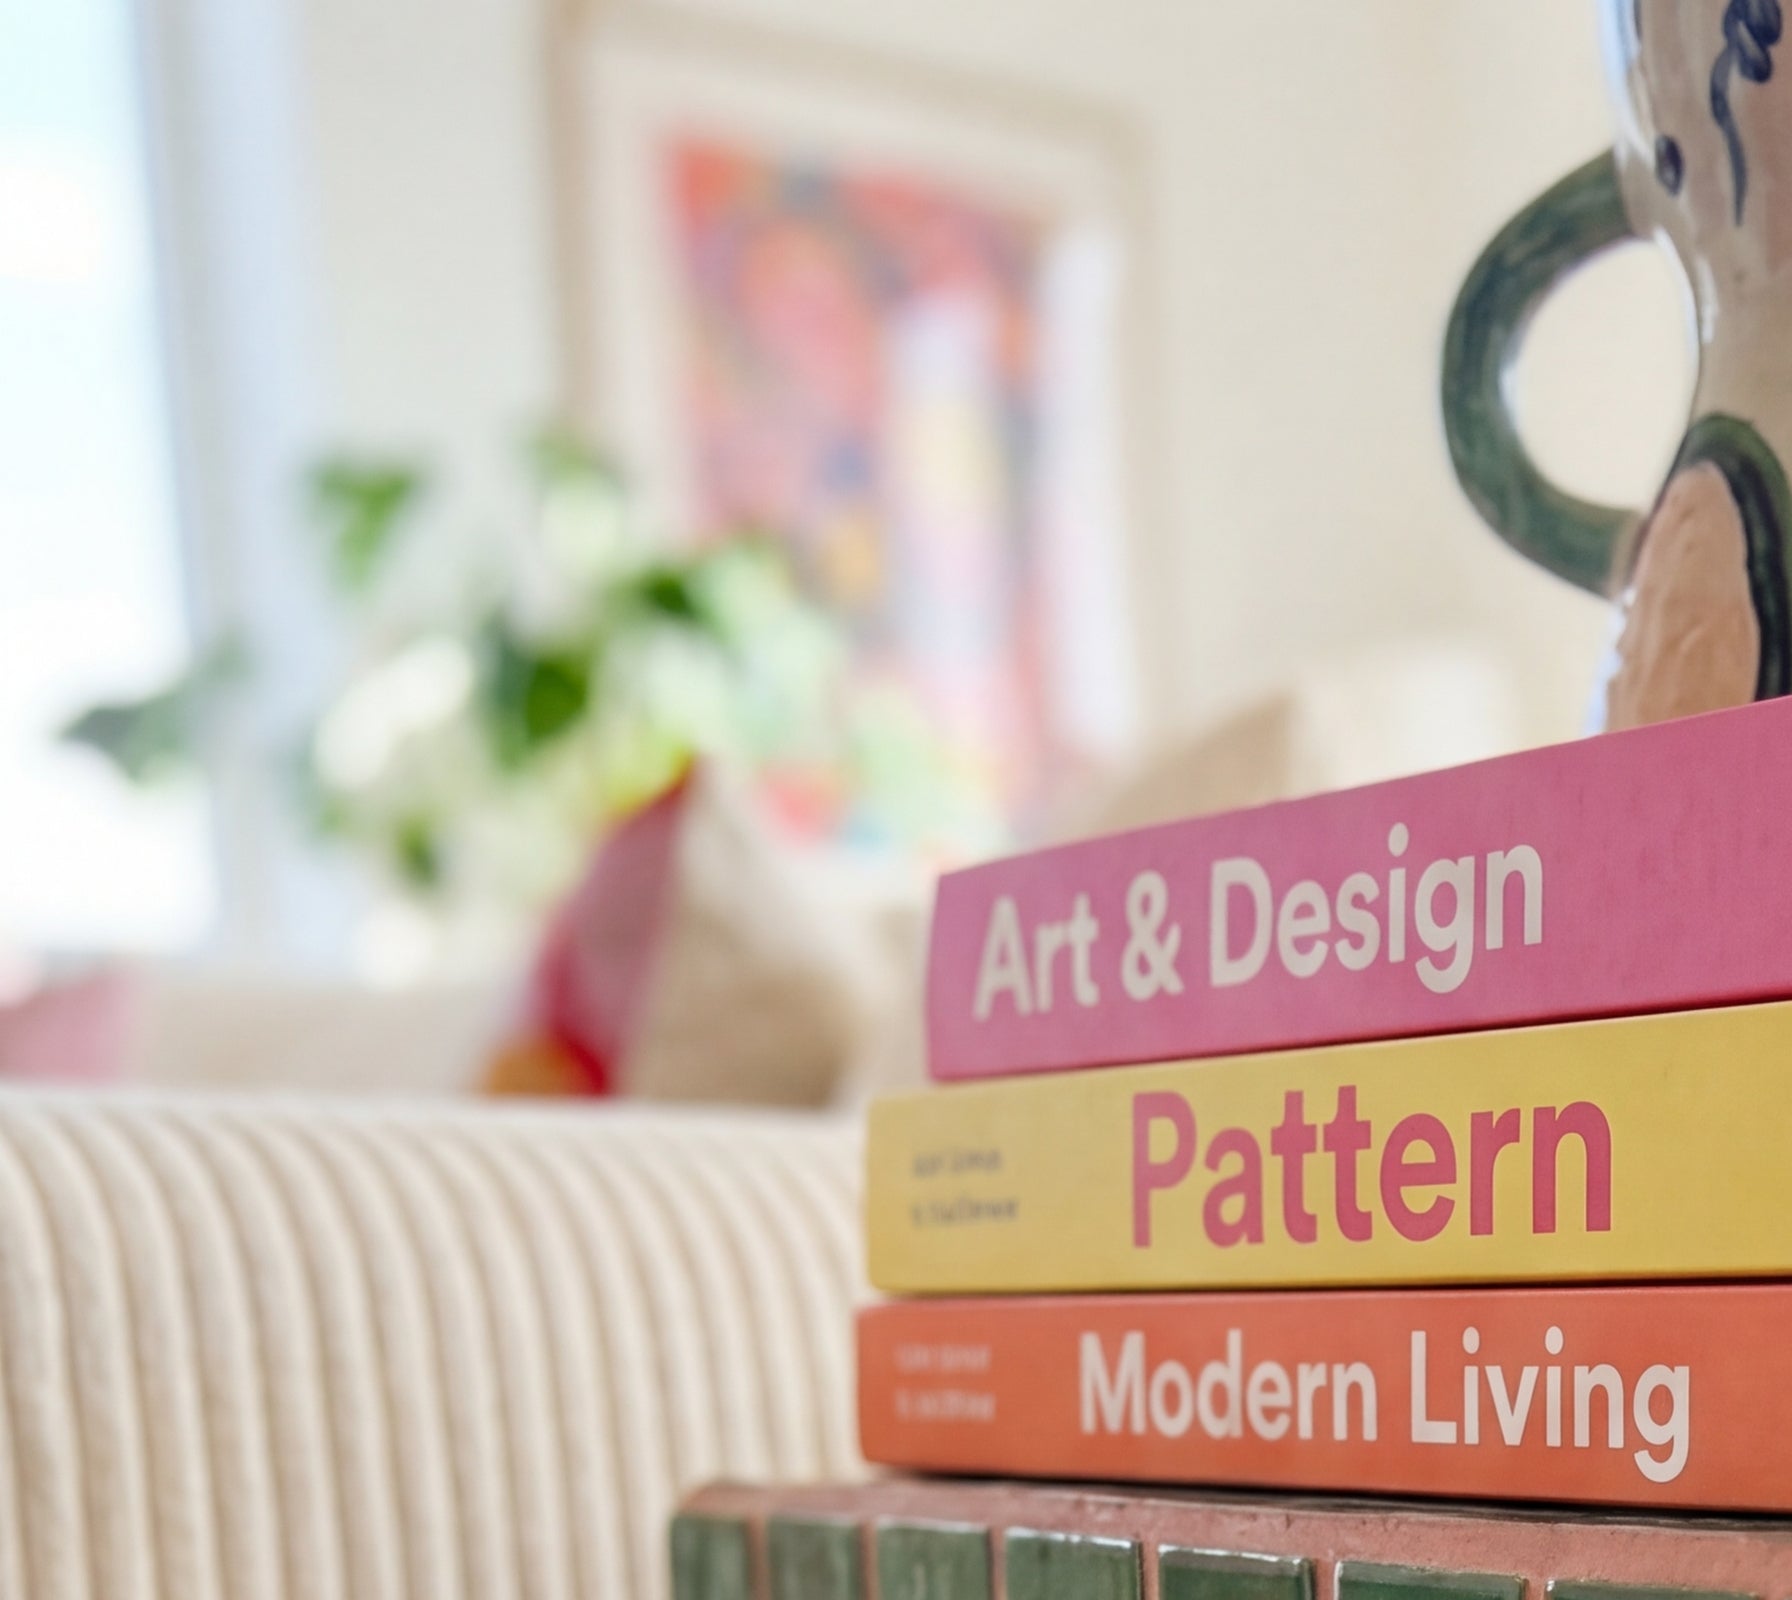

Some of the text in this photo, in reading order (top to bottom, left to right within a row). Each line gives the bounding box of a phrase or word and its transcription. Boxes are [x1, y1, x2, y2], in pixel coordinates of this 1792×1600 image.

[972, 822, 1544, 1022] Art & Design
[1132, 1084, 1613, 1250] Pattern
[1078, 1325, 1691, 1484] Modern Living
